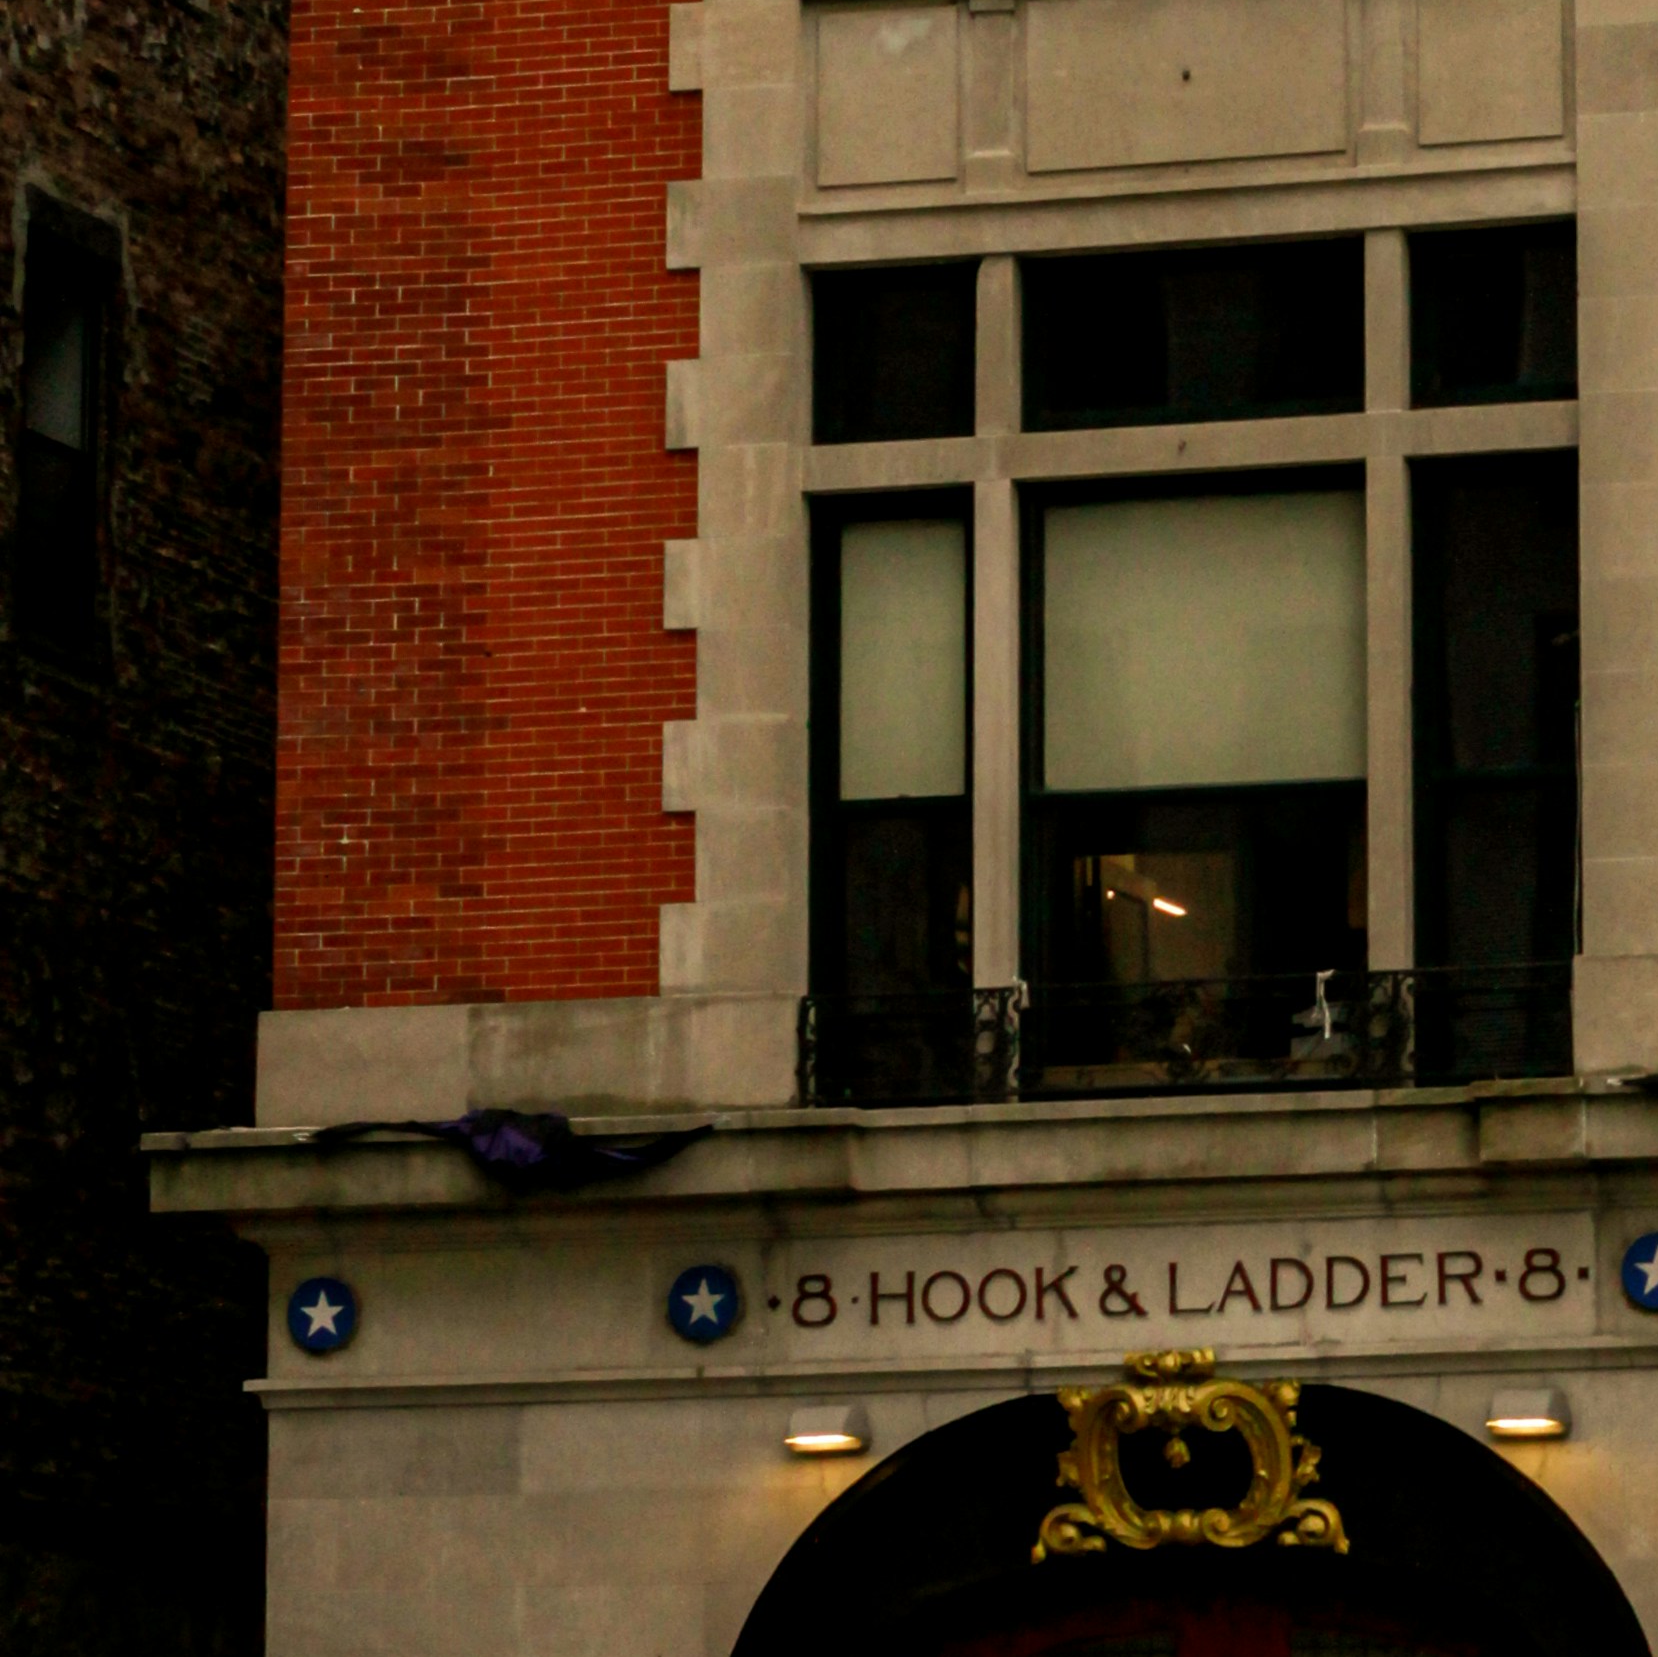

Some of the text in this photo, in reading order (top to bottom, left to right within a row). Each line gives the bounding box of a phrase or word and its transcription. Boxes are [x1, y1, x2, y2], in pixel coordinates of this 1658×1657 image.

[869, 1266, 1079, 1326] HOOK
[1099, 1263, 1148, 1317] &
[1168, 1250, 1483, 1315] LADDER
